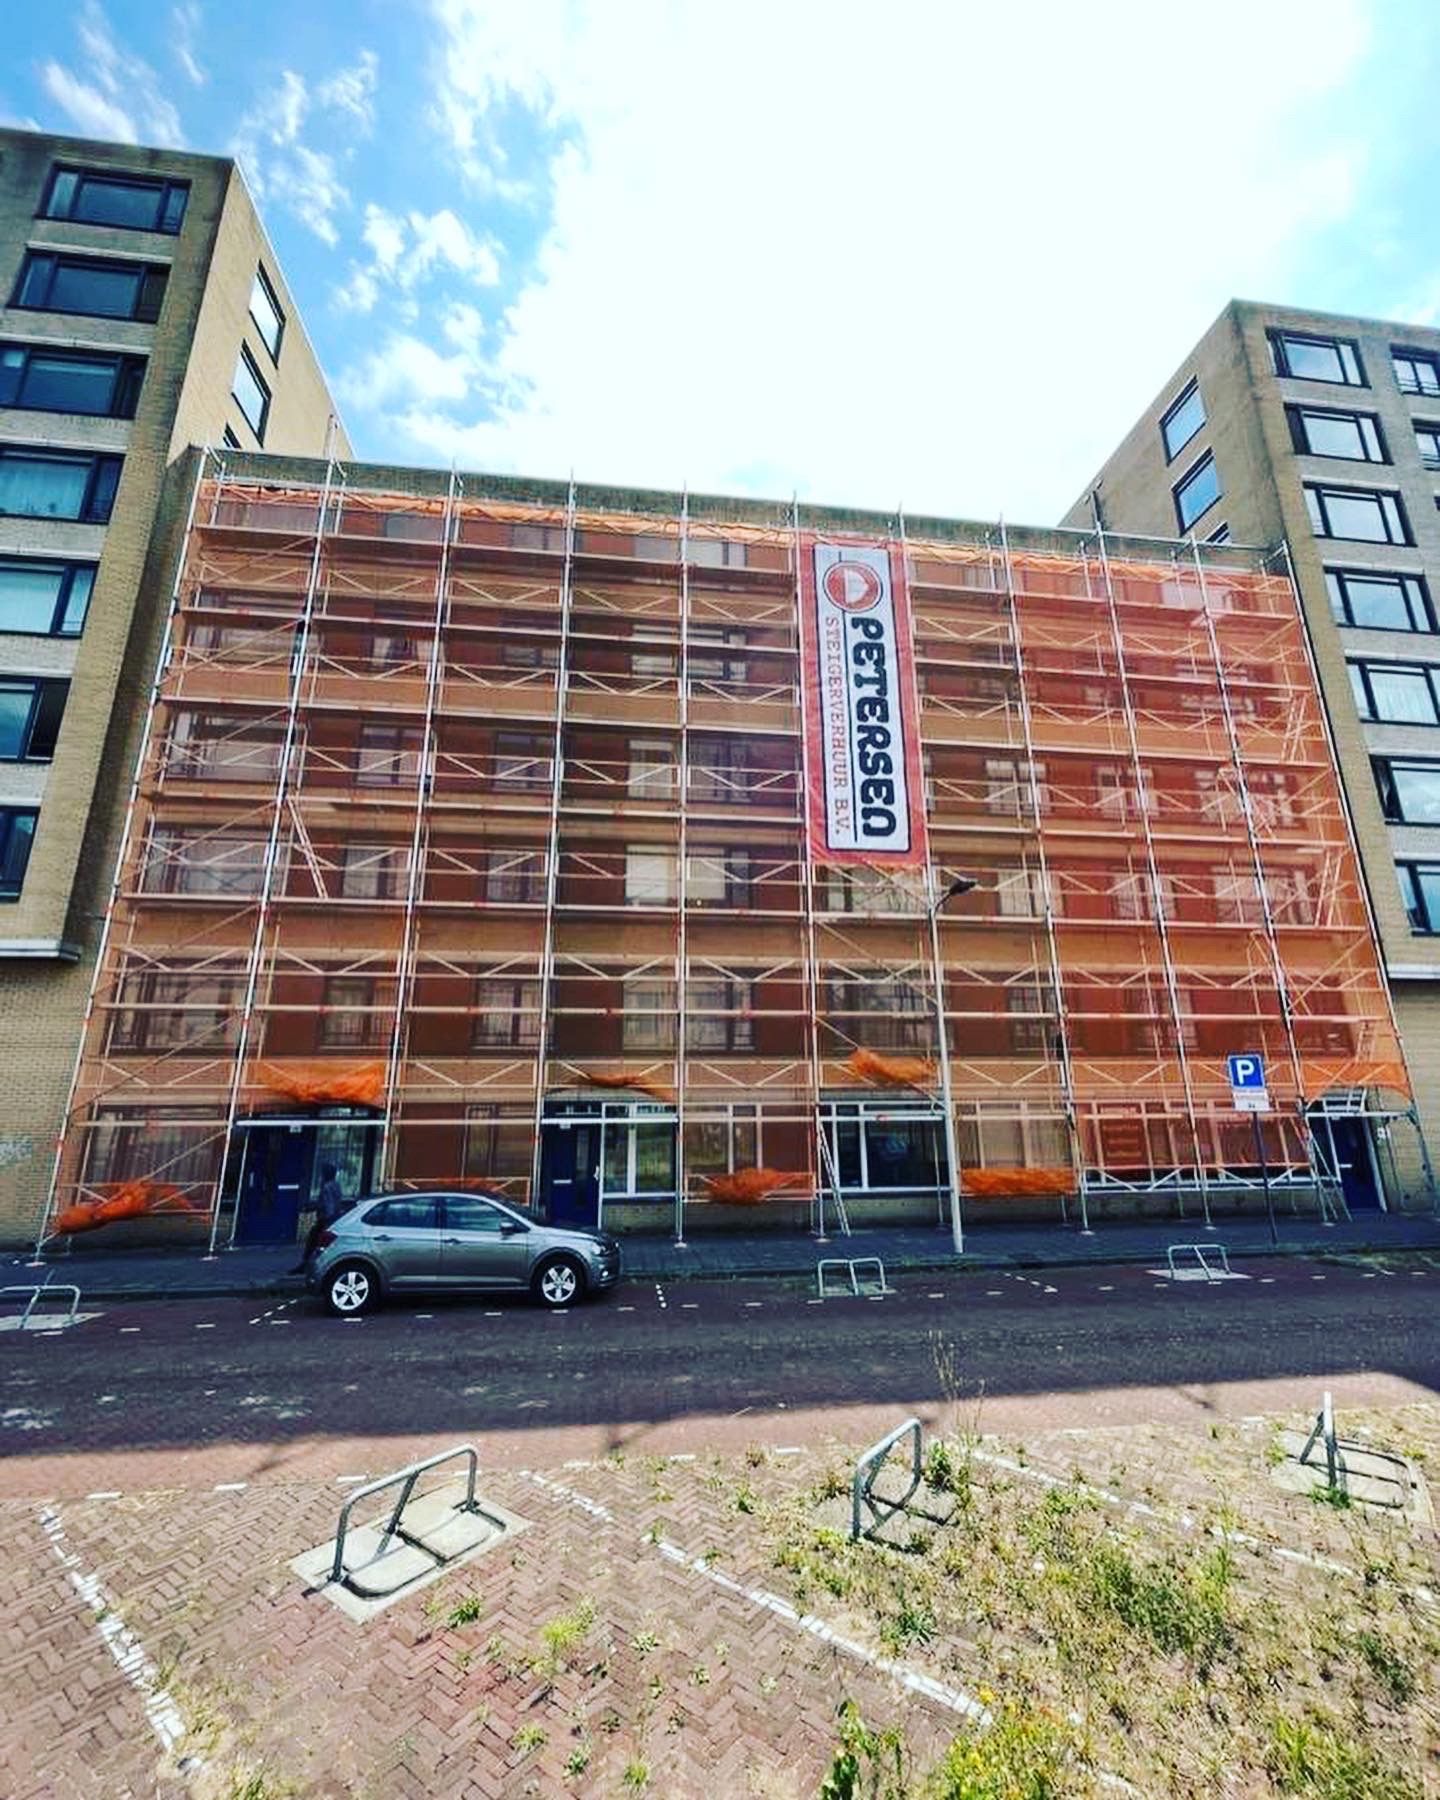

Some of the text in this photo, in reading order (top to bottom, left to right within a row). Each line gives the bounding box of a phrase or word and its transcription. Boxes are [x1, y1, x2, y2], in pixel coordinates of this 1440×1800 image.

[825, 616, 850, 835] STEIGERVERHUUR B.V.
[851, 616, 897, 837] PETERSEN
[1236, 1059, 1255, 1085] P
